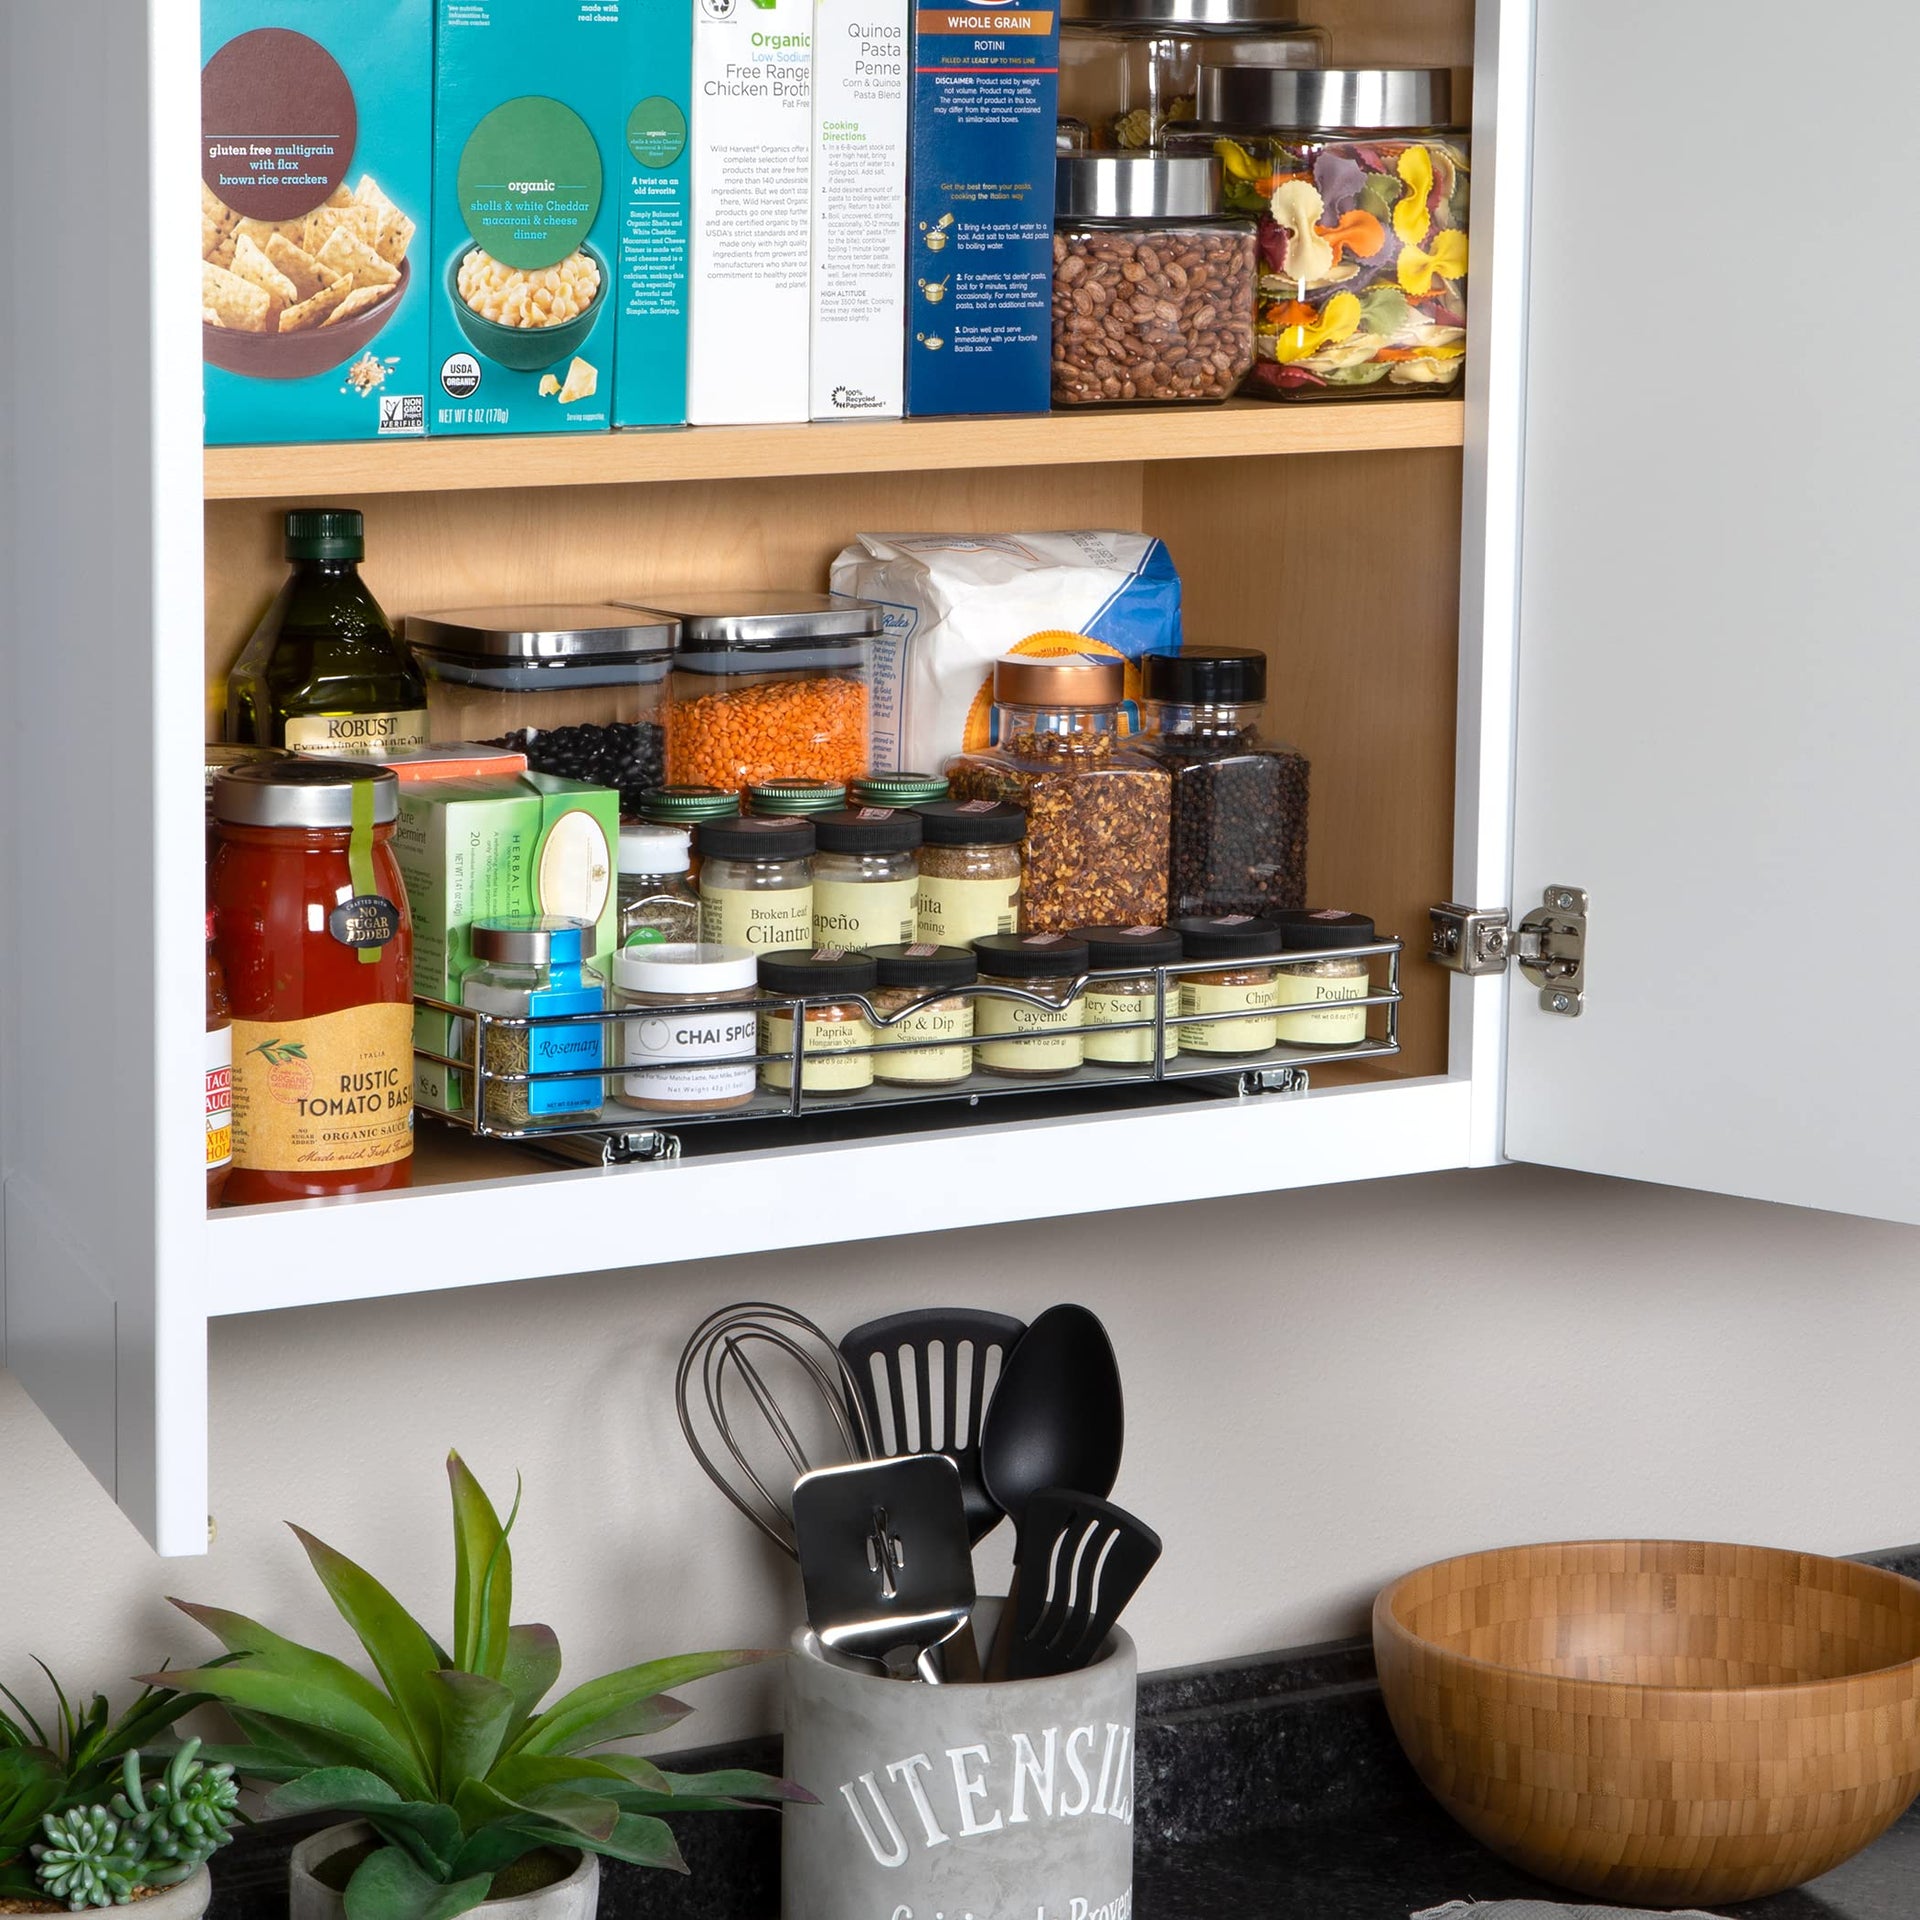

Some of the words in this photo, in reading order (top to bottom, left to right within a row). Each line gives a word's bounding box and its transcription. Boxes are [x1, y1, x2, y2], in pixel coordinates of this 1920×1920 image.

[581, 4, 600, 12] made
[602, 4, 619, 12] with
[577, 14, 593, 22] real
[594, 14, 619, 22] cheese
[948, 16, 991, 28] WHOLE
[994, 16, 1031, 28] GRAIN
[848, 23, 901, 38] Quinoa
[751, 32, 811, 49] Organic
[974, 41, 1005, 50] ROTINI
[861, 42, 901, 57] Pasta
[751, 52, 774, 62] Low
[726, 64, 761, 79] Free
[766, 64, 810, 81] Range
[855, 60, 901, 75] Penne
[704, 80, 768, 96] Chicken
[773, 81, 810, 97] Broth
[842, 79, 863, 88] Corn
[864, 79, 870, 88] &
[872, 79, 901, 88] Quinoa
[854, 91, 877, 100] Pasta
[878, 91, 901, 100] Blend
[782, 100, 795, 108] Fat
[822, 121, 859, 131] Cooking
[822, 132, 867, 141] Directions
[209, 144, 248, 158] gluten
[249, 144, 272, 156] free
[274, 144, 335, 158] multigrain
[249, 159, 276, 171] with
[277, 159, 299, 171] flax
[219, 173, 256, 185] brown
[257, 173, 279, 185] rice
[281, 173, 329, 185] crackers
[631, 177, 638, 186] A
[638, 177, 657, 186] twist
[659, 177, 668, 186] on
[669, 177, 679, 186] an
[508, 179, 556, 195] organic
[634, 187, 647, 196] old
[647, 187, 677, 196] favorite
[470, 200, 503, 211] shells
[505, 200, 513, 211] &
[515, 200, 545, 211] white
[546, 200, 590, 211] Cheddar
[482, 215, 531, 226] macaroni
[533, 215, 541, 226] &
[543, 215, 578, 226] cheese
[514, 229, 548, 240] dinner
[820, 289, 836, 297] HIGH
[837, 289, 867, 297] ALTITUDE
[450, 363, 473, 374] USDA
[446, 376, 476, 386] ORGANIC
[403, 398, 422, 406] NON
[846, 395, 875, 403] Recycled
[403, 405, 422, 413] GMO
[438, 409, 453, 423] NET
[455, 409, 466, 423] WT
[467, 409, 473, 423] 6
[474, 409, 484, 423] OZ
[486, 409, 509, 423] (170g)
[382, 419, 422, 427] VERIFIED
[328, 717, 398, 738] ROBUST
[397, 827, 427, 845] permint
[470, 831, 481, 847] 20
[511, 834, 521, 892] HERBAL
[345, 899, 372, 911] CRAFTED
[373, 899, 388, 908] WITH
[917, 893, 942, 915] jita
[359, 906, 377, 918] NO
[751, 908, 789, 920] Broken
[791, 905, 808, 918] Leaf
[345, 916, 389, 931] SUGAR
[813, 913, 860, 933] apeño
[917, 919, 946, 936] oning
[346, 927, 391, 942] ADDED
[746, 925, 810, 944] Cilantro
[1084, 996, 1107, 1014] lery
[1110, 999, 1142, 1013] Seed
[915, 1016, 928, 1030] &
[932, 1016, 955, 1033] Dip
[1013, 1009, 1068, 1026] Cayenne
[676, 1029, 720, 1045] CHAI
[725, 1021, 755, 1042] SPICE
[816, 1026, 853, 1039] Paprika
[359, 1051, 386, 1060] ITALIA
[538, 1038, 600, 1059] Rosemary
[206, 1070, 231, 1091] TACO
[340, 1067, 398, 1093] RUSTIC
[206, 1091, 231, 1111] AUCE
[297, 1094, 382, 1117] TOMATO
[322, 1128, 378, 1142] ORGANIC
[380, 1120, 406, 1136] SAUCE
[297, 1150, 335, 1163] Made
[337, 1148, 365, 1161] with
